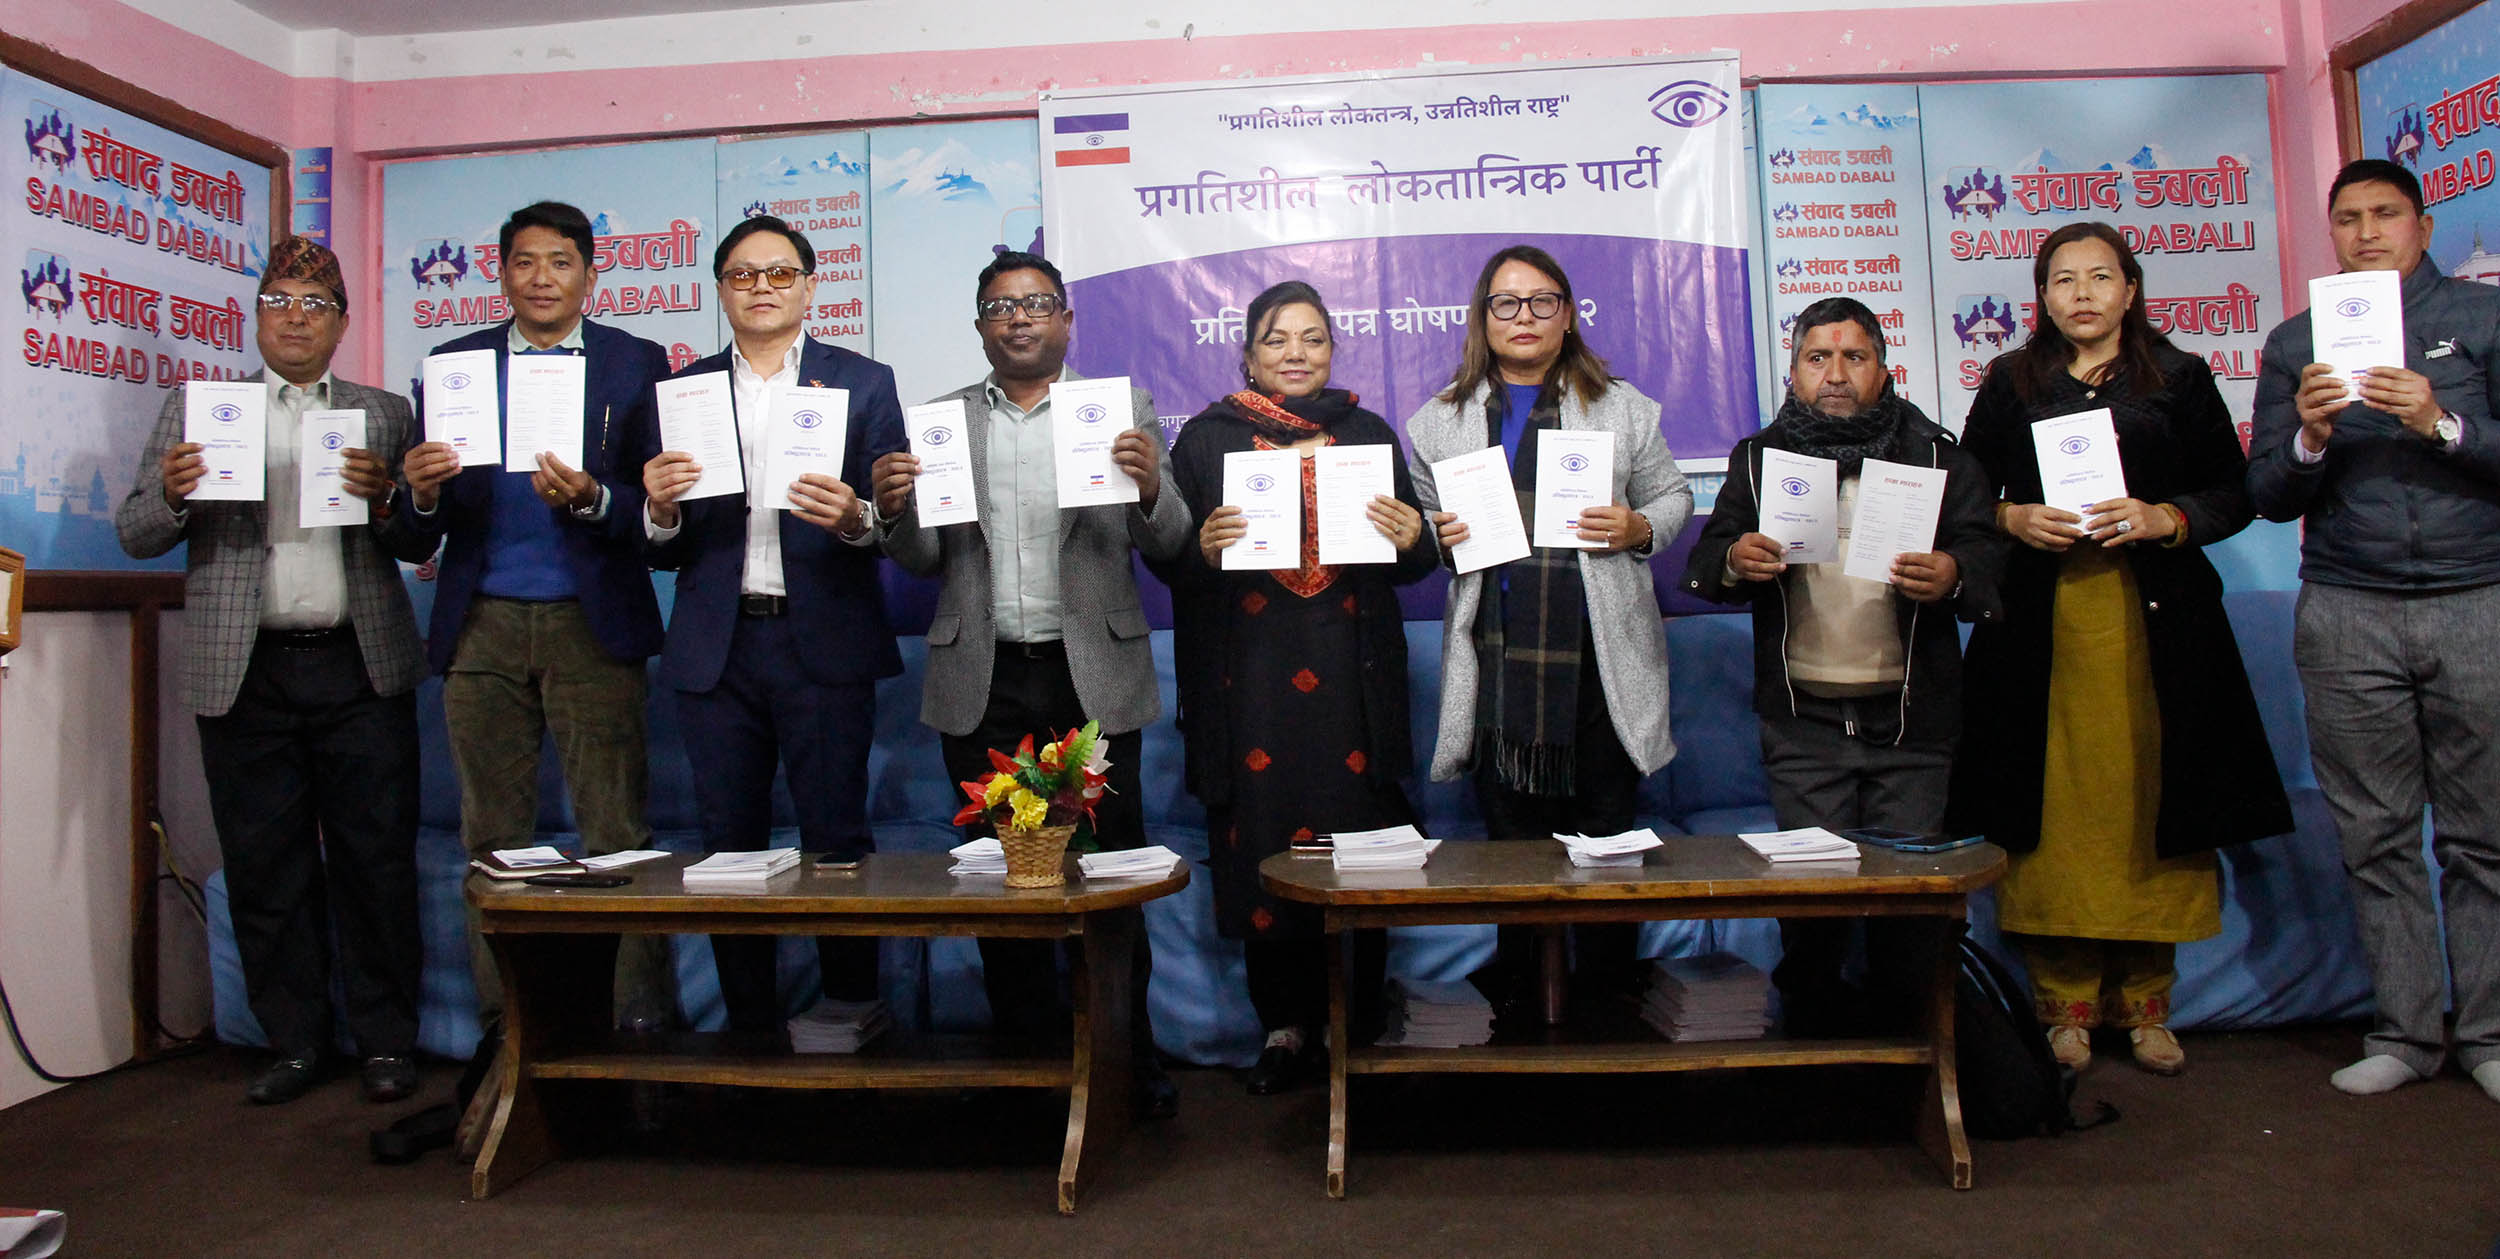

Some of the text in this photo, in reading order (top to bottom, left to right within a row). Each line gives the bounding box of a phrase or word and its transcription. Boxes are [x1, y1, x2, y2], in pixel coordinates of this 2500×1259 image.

[1218, 94, 1570, 130] "प्रगतिशील लोकतन्त्र, उन्नतिशील राष्ट्र"
[2426, 74, 2500, 149] संवाद
[1798, 145, 1893, 166] संवाद डबली
[81, 127, 245, 225] संवाद डबली
[1134, 146, 1662, 217] प्रगतिशील लोकतान्त्रिक पार्टी
[1772, 170, 1895, 184] SAMBAD DABALI
[2011, 155, 2249, 213] संवाद डबली
[2422, 149, 2495, 208] MBAD
[770, 190, 861, 217] संवाद डबली
[1801, 198, 1897, 220] संवाद डबली
[26, 177, 245, 274] SAMBAD DABALI
[809, 216, 862, 231] DABALI
[1776, 225, 1898, 239] SAMBAD DABALI
[1950, 220, 2255, 260] SAMB DABALI
[817, 243, 862, 265] डबली
[1805, 254, 1901, 276] संवाद डबली
[1778, 280, 1903, 294] SAMBAD DABALI
[79, 267, 245, 352] संवाद डबली
[413, 294, 515, 328] SAMB
[818, 298, 863, 319] डबली
[1385, 297, 1472, 335] घोषण
[2145, 282, 2258, 335] डबली
[811, 323, 864, 338] DABALI
[1885, 335, 1906, 347] ALI
[23, 328, 149, 384] SAMBAD
[2205, 348, 2263, 380] ALI
